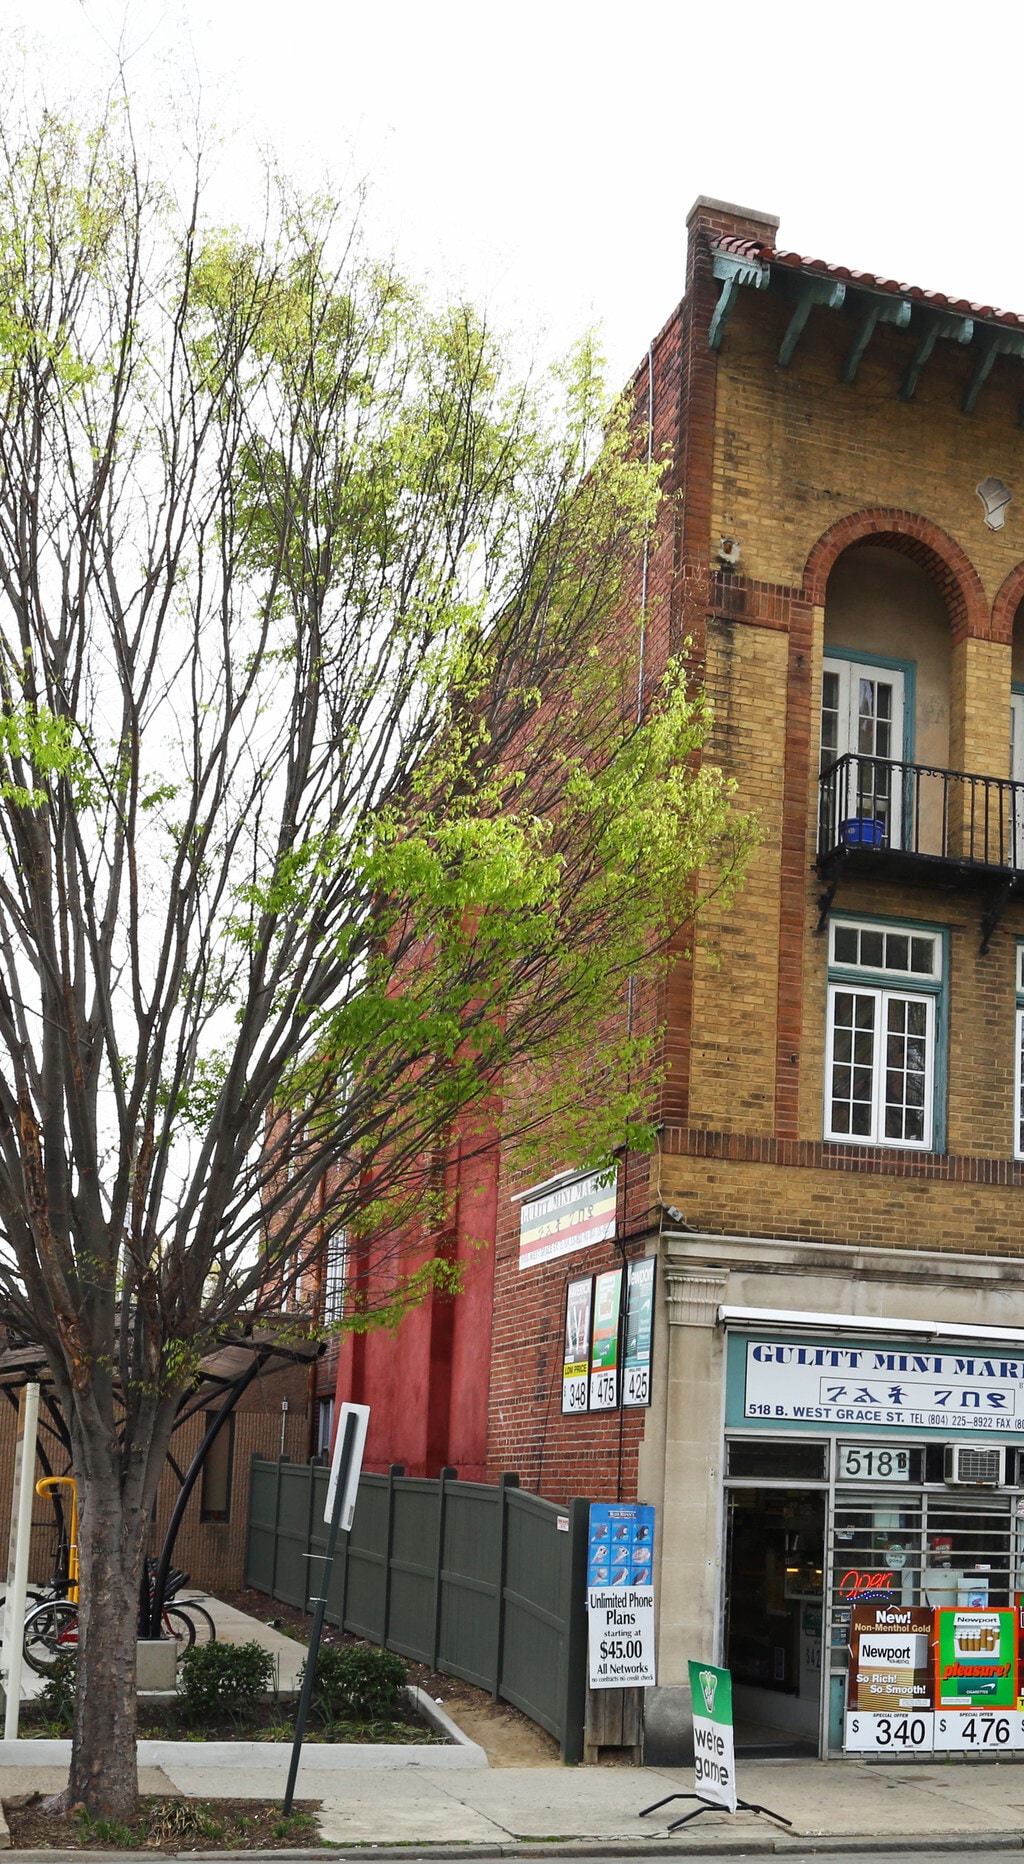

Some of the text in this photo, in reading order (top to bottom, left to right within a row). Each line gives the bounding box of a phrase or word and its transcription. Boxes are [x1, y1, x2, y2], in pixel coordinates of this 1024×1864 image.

[752, 1344, 864, 1369] GULITT
[872, 1353, 942, 1374] MINI
[565, 1363, 587, 1375] LOW PRICE
[749, 1403, 771, 1415] 518
[776, 1405, 788, 1416] B.
[793, 1406, 832, 1419] WEST
[836, 1408, 881, 1421] GRACE
[886, 1411, 905, 1423] ST.
[910, 1413, 924, 1424] TEL
[928, 1414, 948, 1425] (804)
[996, 1418, 1011, 1428] FAX
[840, 1570, 894, 1598] Open
[590, 1592, 653, 1609] Unlimited Phone
[606, 1609, 636, 1625] Plans
[876, 1610, 911, 1624] New!
[957, 1616, 997, 1624] Newport
[604, 1629, 632, 1638] starting
[854, 1623, 931, 1633] Non-Menthol Gold
[600, 1640, 643, 1662] $45.00
[862, 1644, 911, 1661] Newport
[597, 1662, 648, 1674] All Networks
[942, 1661, 1011, 1681] pleasure!
[856, 1673, 897, 1684] So Rich!
[870, 1684, 926, 1694] So Smooth!
[852, 1719, 926, 1747] $ 3.40
[939, 1718, 1010, 1746] $ 4.76
[695, 1726, 725, 1756] we're
[694, 1755, 729, 1786] game
